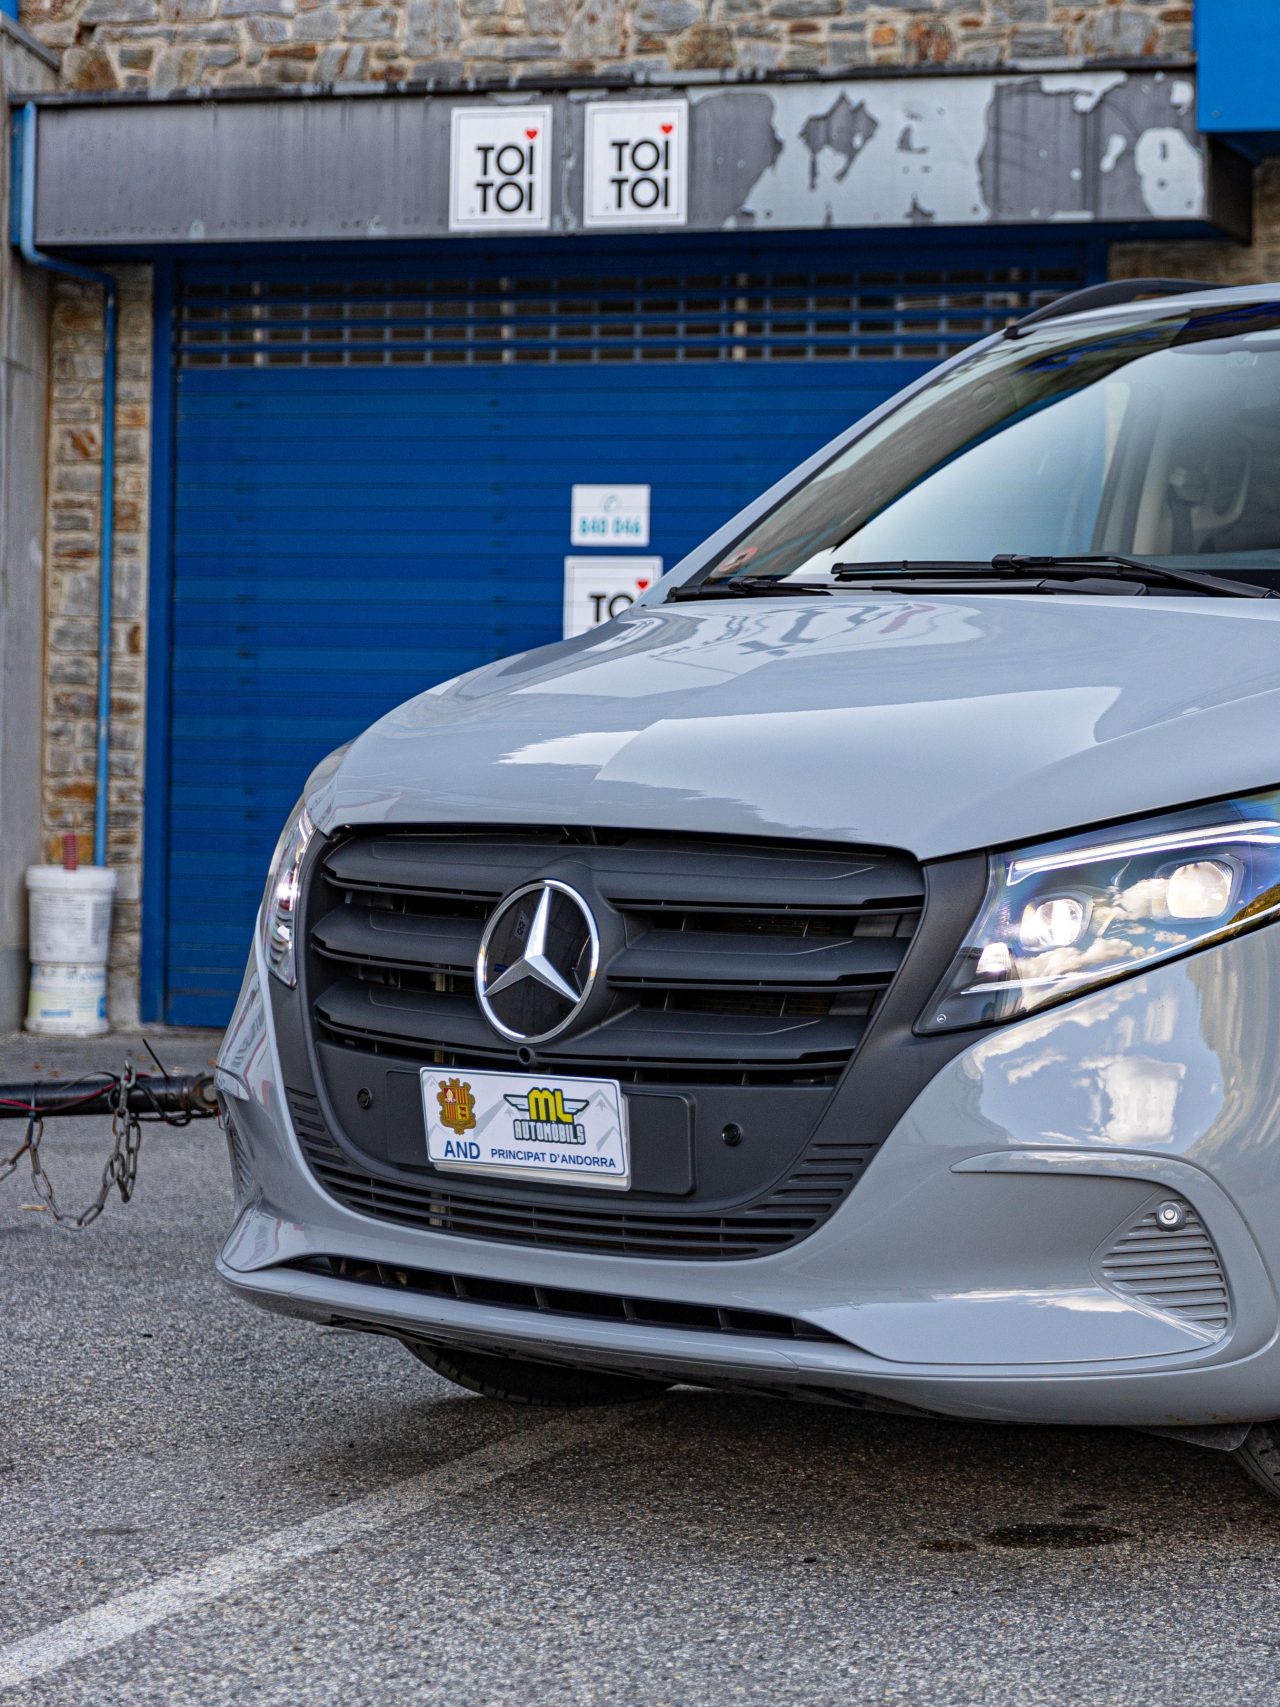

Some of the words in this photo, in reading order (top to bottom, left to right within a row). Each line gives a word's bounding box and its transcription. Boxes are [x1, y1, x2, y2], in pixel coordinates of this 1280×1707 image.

[477, 145, 534, 176] TOI
[611, 140, 669, 171] TOI
[477, 182, 533, 212] TOI
[611, 177, 669, 208] TOI
[527, 1088, 574, 1123] ML
[444, 1140, 481, 1160] AND
[490, 1148, 547, 1163] PRINCIPAT
[550, 1154, 617, 1169] D'ANDORRA
